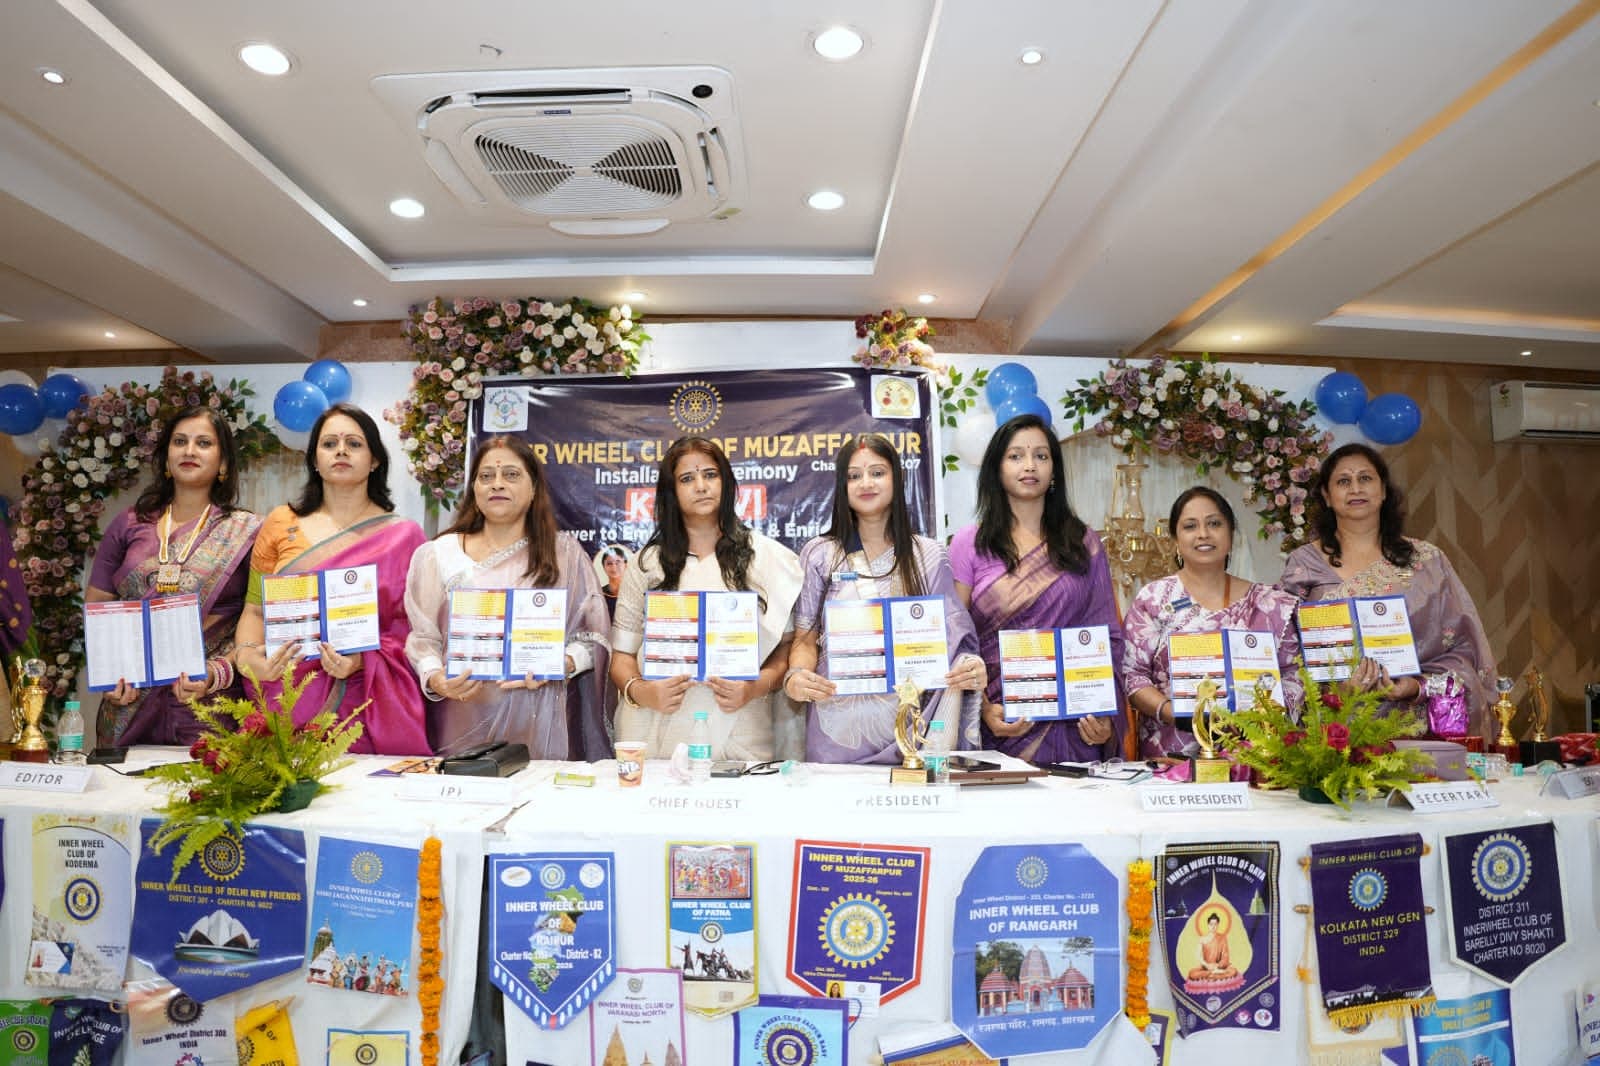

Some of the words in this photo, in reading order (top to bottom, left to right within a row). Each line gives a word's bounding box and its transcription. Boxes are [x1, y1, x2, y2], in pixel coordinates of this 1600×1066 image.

[554, 441, 634, 464] WHEEL
[595, 465, 659, 484] Installa
[600, 527, 617, 541] to
[15, 772, 63, 784] EDITOR
[648, 796, 689, 808] CHIEF
[695, 798, 742, 809] GUEST
[1148, 794, 1176, 806] VICE
[1179, 793, 1242, 805] PRESIDENT
[58, 840, 79, 848] INNER
[81, 840, 104, 848] WHEEL
[67, 850, 84, 858] CLUB
[87, 850, 96, 858] OF
[809, 852, 843, 863] INNER
[845, 855, 883, 866] WHEEL
[886, 858, 916, 868] CLUB
[1319, 855, 1346, 865] INNER
[1348, 852, 1377, 862] WHEEL
[1379, 849, 1402, 859] CLUB
[1404, 847, 1416, 855] OF
[65, 860, 98, 868] KODERMA
[820, 864, 833, 872] OF
[835, 865, 902, 876] MUZAFFARPUR
[1166, 864, 1190, 885] INNER
[1189, 856, 1216, 870] WHEEL
[1217, 855, 1239, 866] CLUB
[1238, 859, 1249, 870] OF
[1248, 863, 1266, 881] GAYA
[141, 881, 164, 891] INNER
[194, 885, 213, 895] CLUB
[215, 886, 225, 896] OF
[227, 886, 249, 897] DELHI
[251, 888, 267, 899] NEW
[269, 891, 302, 901] FRIENDS
[505, 902, 538, 912] INNER
[540, 901, 575, 912] WHEEL
[577, 901, 604, 911] CLUB
[969, 905, 1008, 920] INNER
[1011, 904, 1059, 915] WHEEL
[1063, 903, 1099, 915] CLUB
[1478, 905, 1514, 919] DISTRICT
[1515, 902, 1530, 912] 311
[988, 921, 1006, 934] OF
[1009, 920, 1078, 932] RAMGARH
[1320, 919, 1368, 935] KOLKATA
[1371, 915, 1394, 927] NEW
[1397, 911, 1421, 924] GEN
[1463, 918, 1512, 937] INNERWHEEL
[1514, 914, 1538, 927] CLUB
[1540, 913, 1552, 925] OF
[1343, 930, 1380, 945] DISTRICT
[1500, 931, 1520, 943] DIVY
[1521, 928, 1554, 941] SHAKTI
[1359, 945, 1386, 957] INDIA
[1473, 947, 1508, 964] CHARTER
[1511, 946, 1523, 956] NO
[620, 1002, 642, 1010] WHEEL
[165, 1030, 187, 1040] Wheel
[179, 1040, 198, 1049] INDIA
